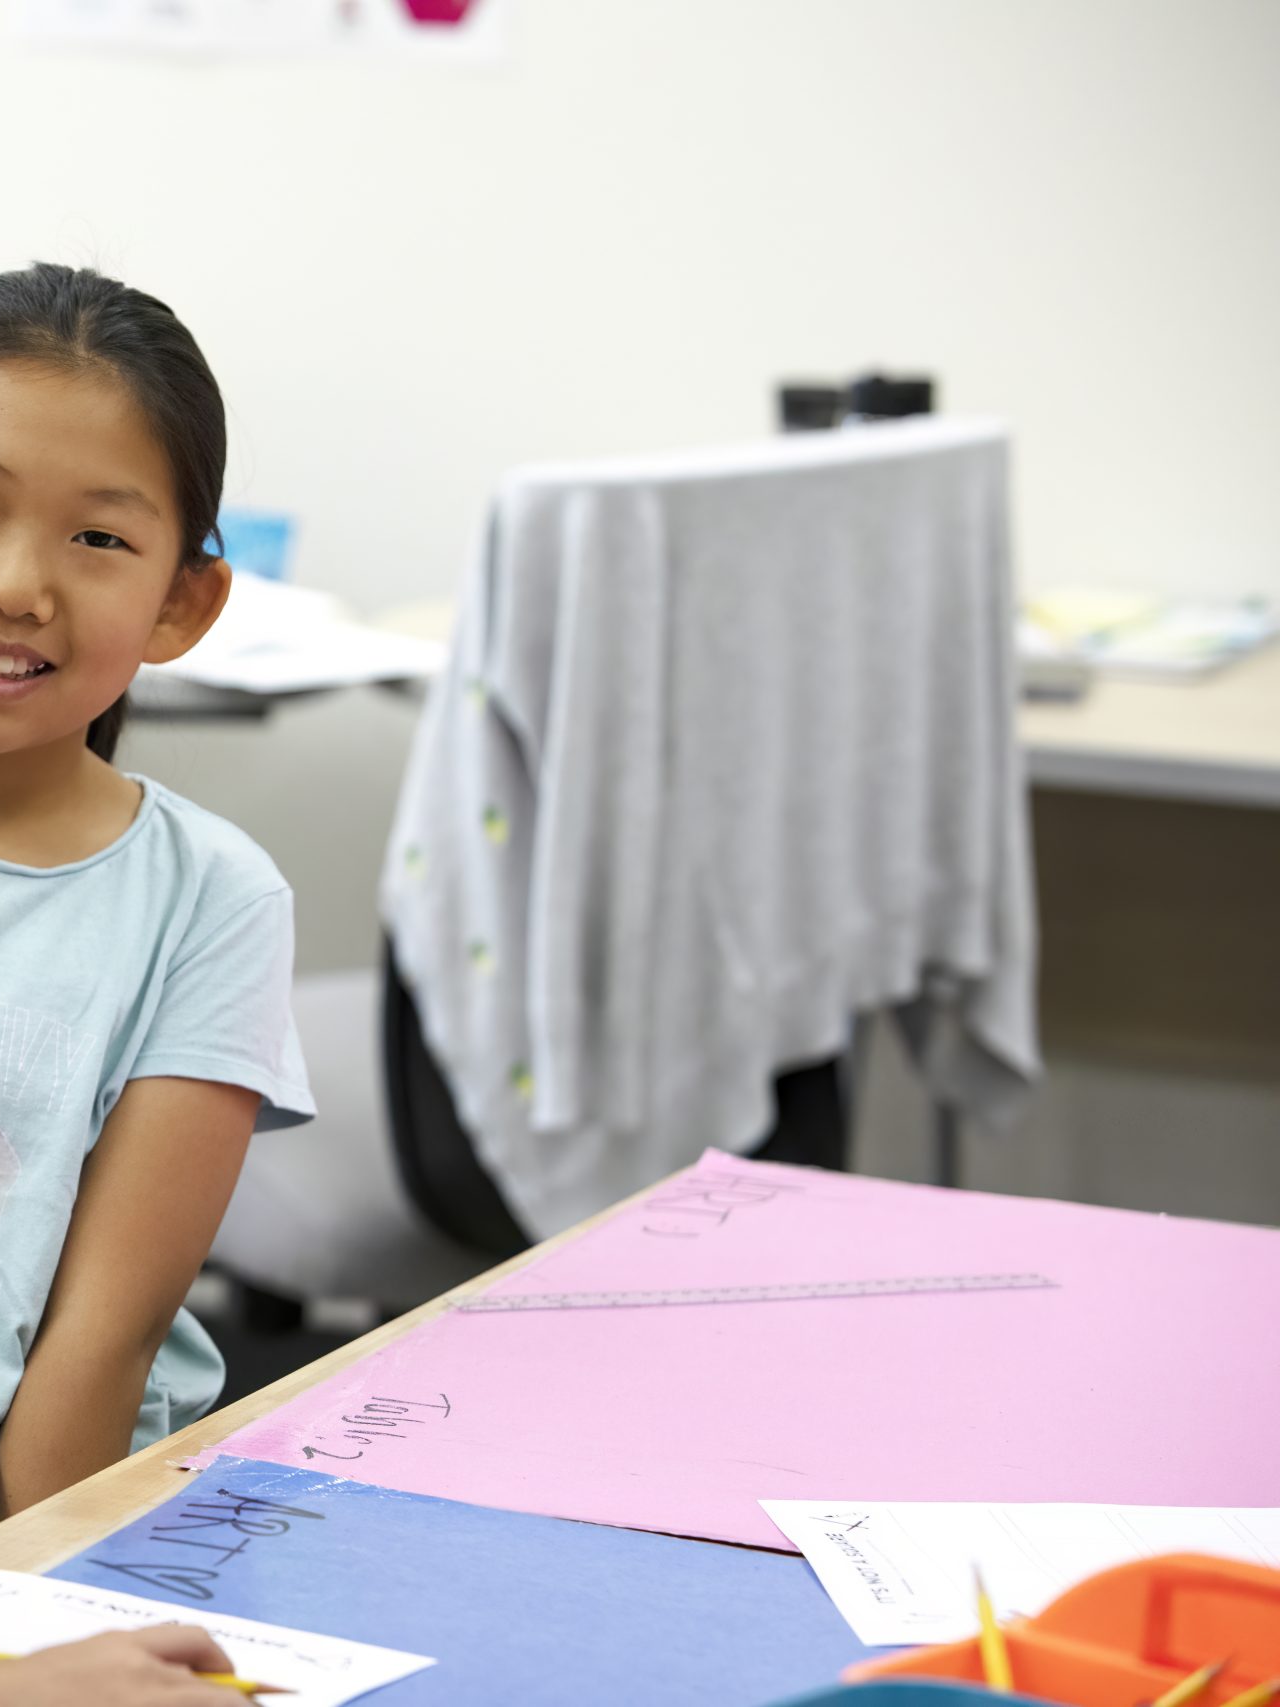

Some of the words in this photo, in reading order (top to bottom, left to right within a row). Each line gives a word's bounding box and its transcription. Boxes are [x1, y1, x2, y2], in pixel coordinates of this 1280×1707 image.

[644, 1170, 807, 1226] ART
[149, 1488, 326, 1567] ART
[855, 1566, 883, 1585] NOT
